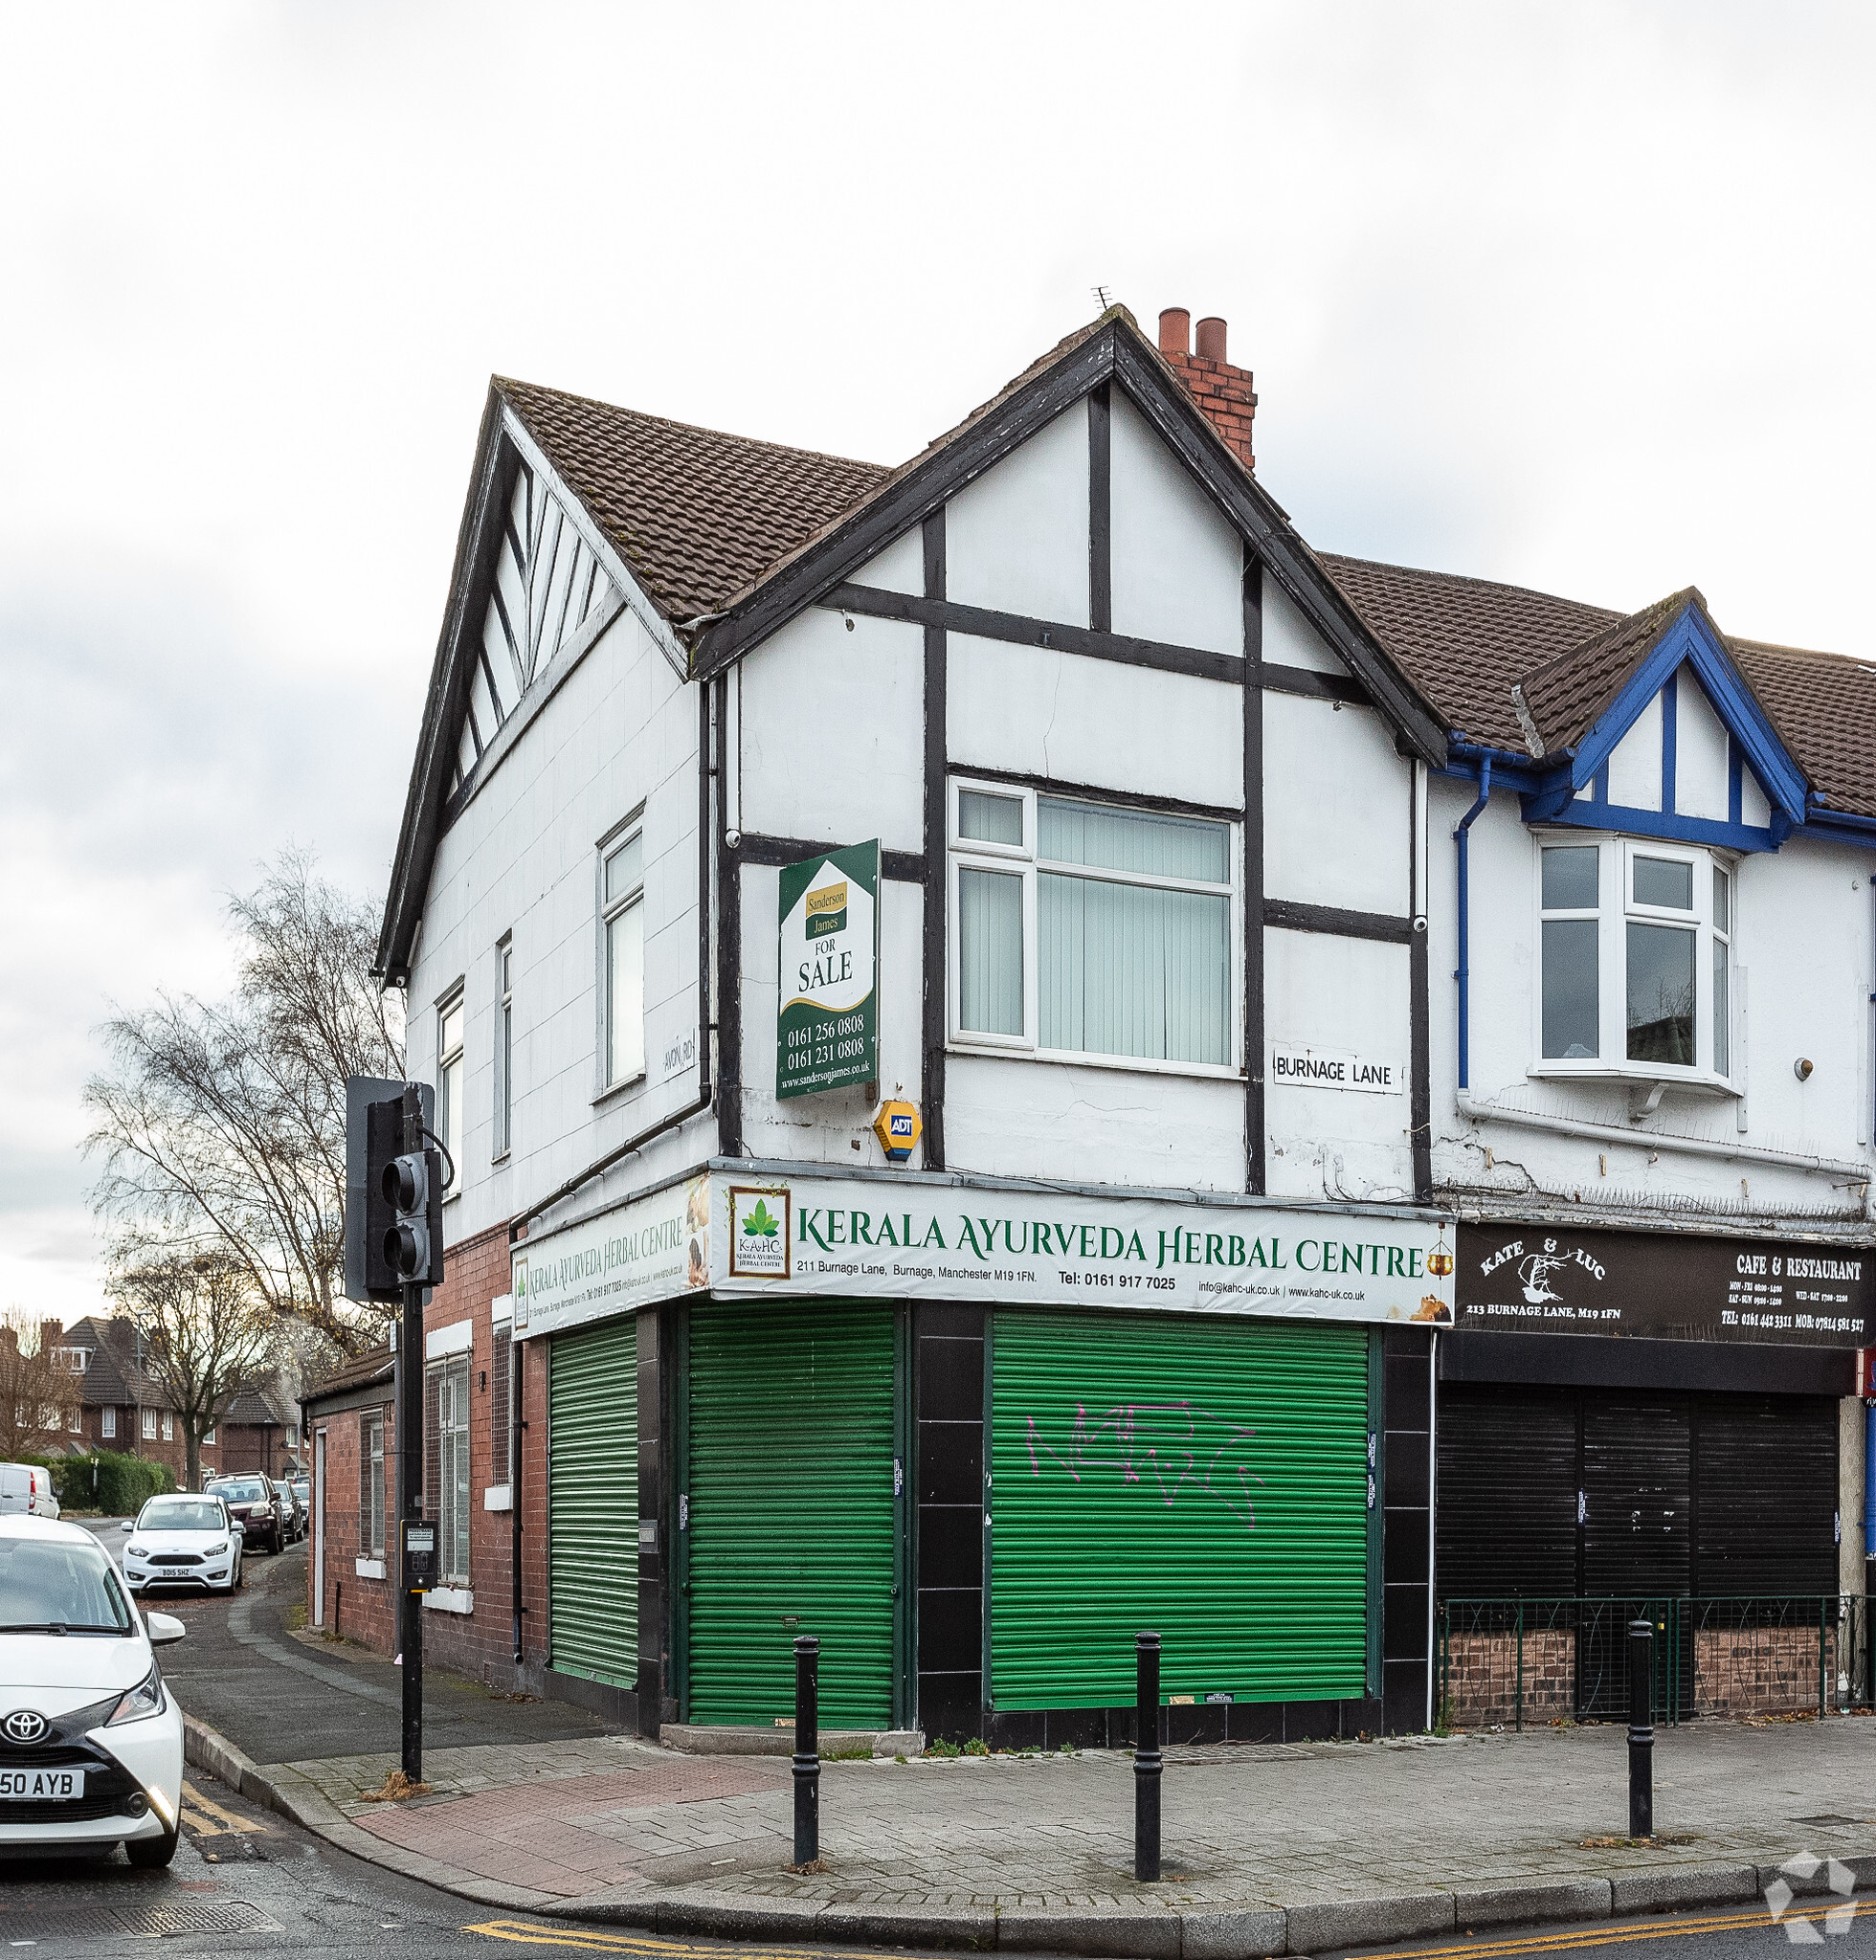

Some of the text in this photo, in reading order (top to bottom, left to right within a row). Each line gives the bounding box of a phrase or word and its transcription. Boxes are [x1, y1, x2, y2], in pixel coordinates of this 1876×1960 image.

[808, 891, 845, 912] Sanderson
[814, 916, 838, 934] James
[815, 938, 837, 956] FOR
[798, 950, 853, 993] SALE
[788, 1013, 864, 1048] 0161 256 0808
[788, 1036, 864, 1071] 0161 231 0808
[781, 1060, 870, 1089] www.sandersonjames.co.uk
[1277, 1057, 1392, 1085] BURNAGE LANE
[892, 1118, 912, 1133] ADT
[797, 1207, 1425, 1280] KERALA AYURVEDA HERBAL CENTRE
[529, 1215, 682, 1300] KERALA AYURVEDA HERBAL CENTRE
[1480, 1237, 1606, 1281] KATE & LUC
[1736, 1254, 1862, 1281] CAFE & RESTAURANT
[796, 1260, 1037, 1282] 211 Burnage Lane, Burnage, Manchester M19 1FN.
[1059, 1270, 1175, 1290] Tel: 0161 917 7025
[1198, 1281, 1281, 1297] info@kahc-uk.co.uk
[1289, 1286, 1365, 1302] www.kahc-uk.co.uk
[1466, 1304, 1621, 1320] 213 BURNAGE LANE, M19 1FN
[1721, 1310, 1739, 1325] TEL:
[1742, 1312, 1759, 1326] 0161
[1761, 1313, 1774, 1328] 442
[1774, 1315, 1792, 1329] 3311
[1795, 1314, 1815, 1328] MOB:
[1815, 1316, 1836, 1331] 07814
[1837, 1318, 1850, 1331] 581
[33, 1773, 73, 1794] AYB
